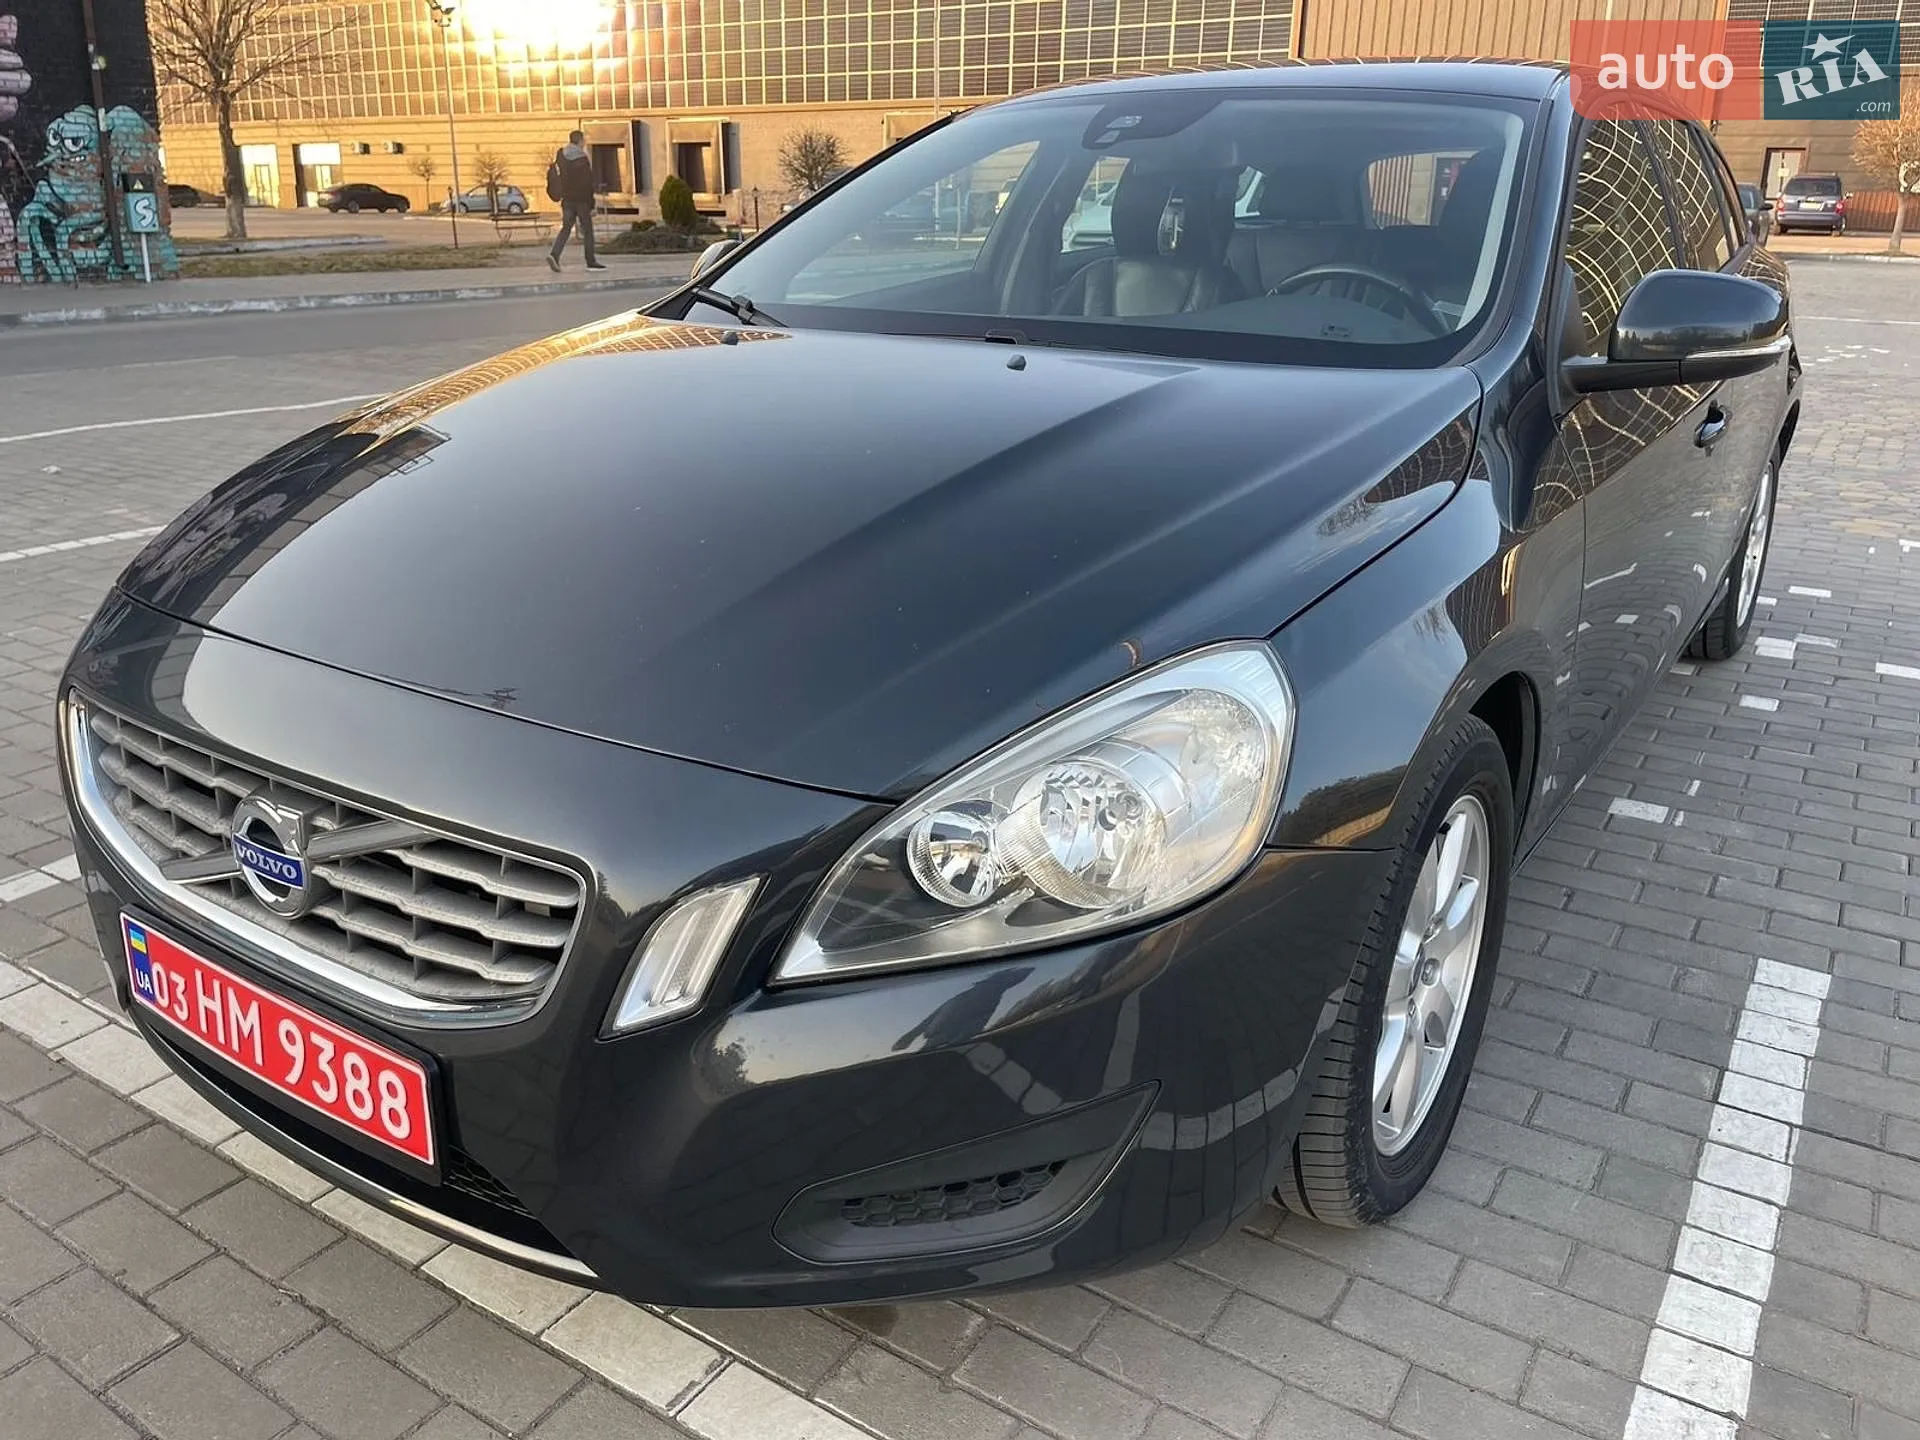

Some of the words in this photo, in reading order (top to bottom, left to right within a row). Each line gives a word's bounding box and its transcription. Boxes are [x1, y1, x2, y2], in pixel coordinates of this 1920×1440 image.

[235, 842, 298, 879] VOLVO
[136, 971, 154, 994] UA
[151, 962, 189, 1022] 03
[194, 968, 264, 1067] HM
[278, 1018, 411, 1140] 9388
